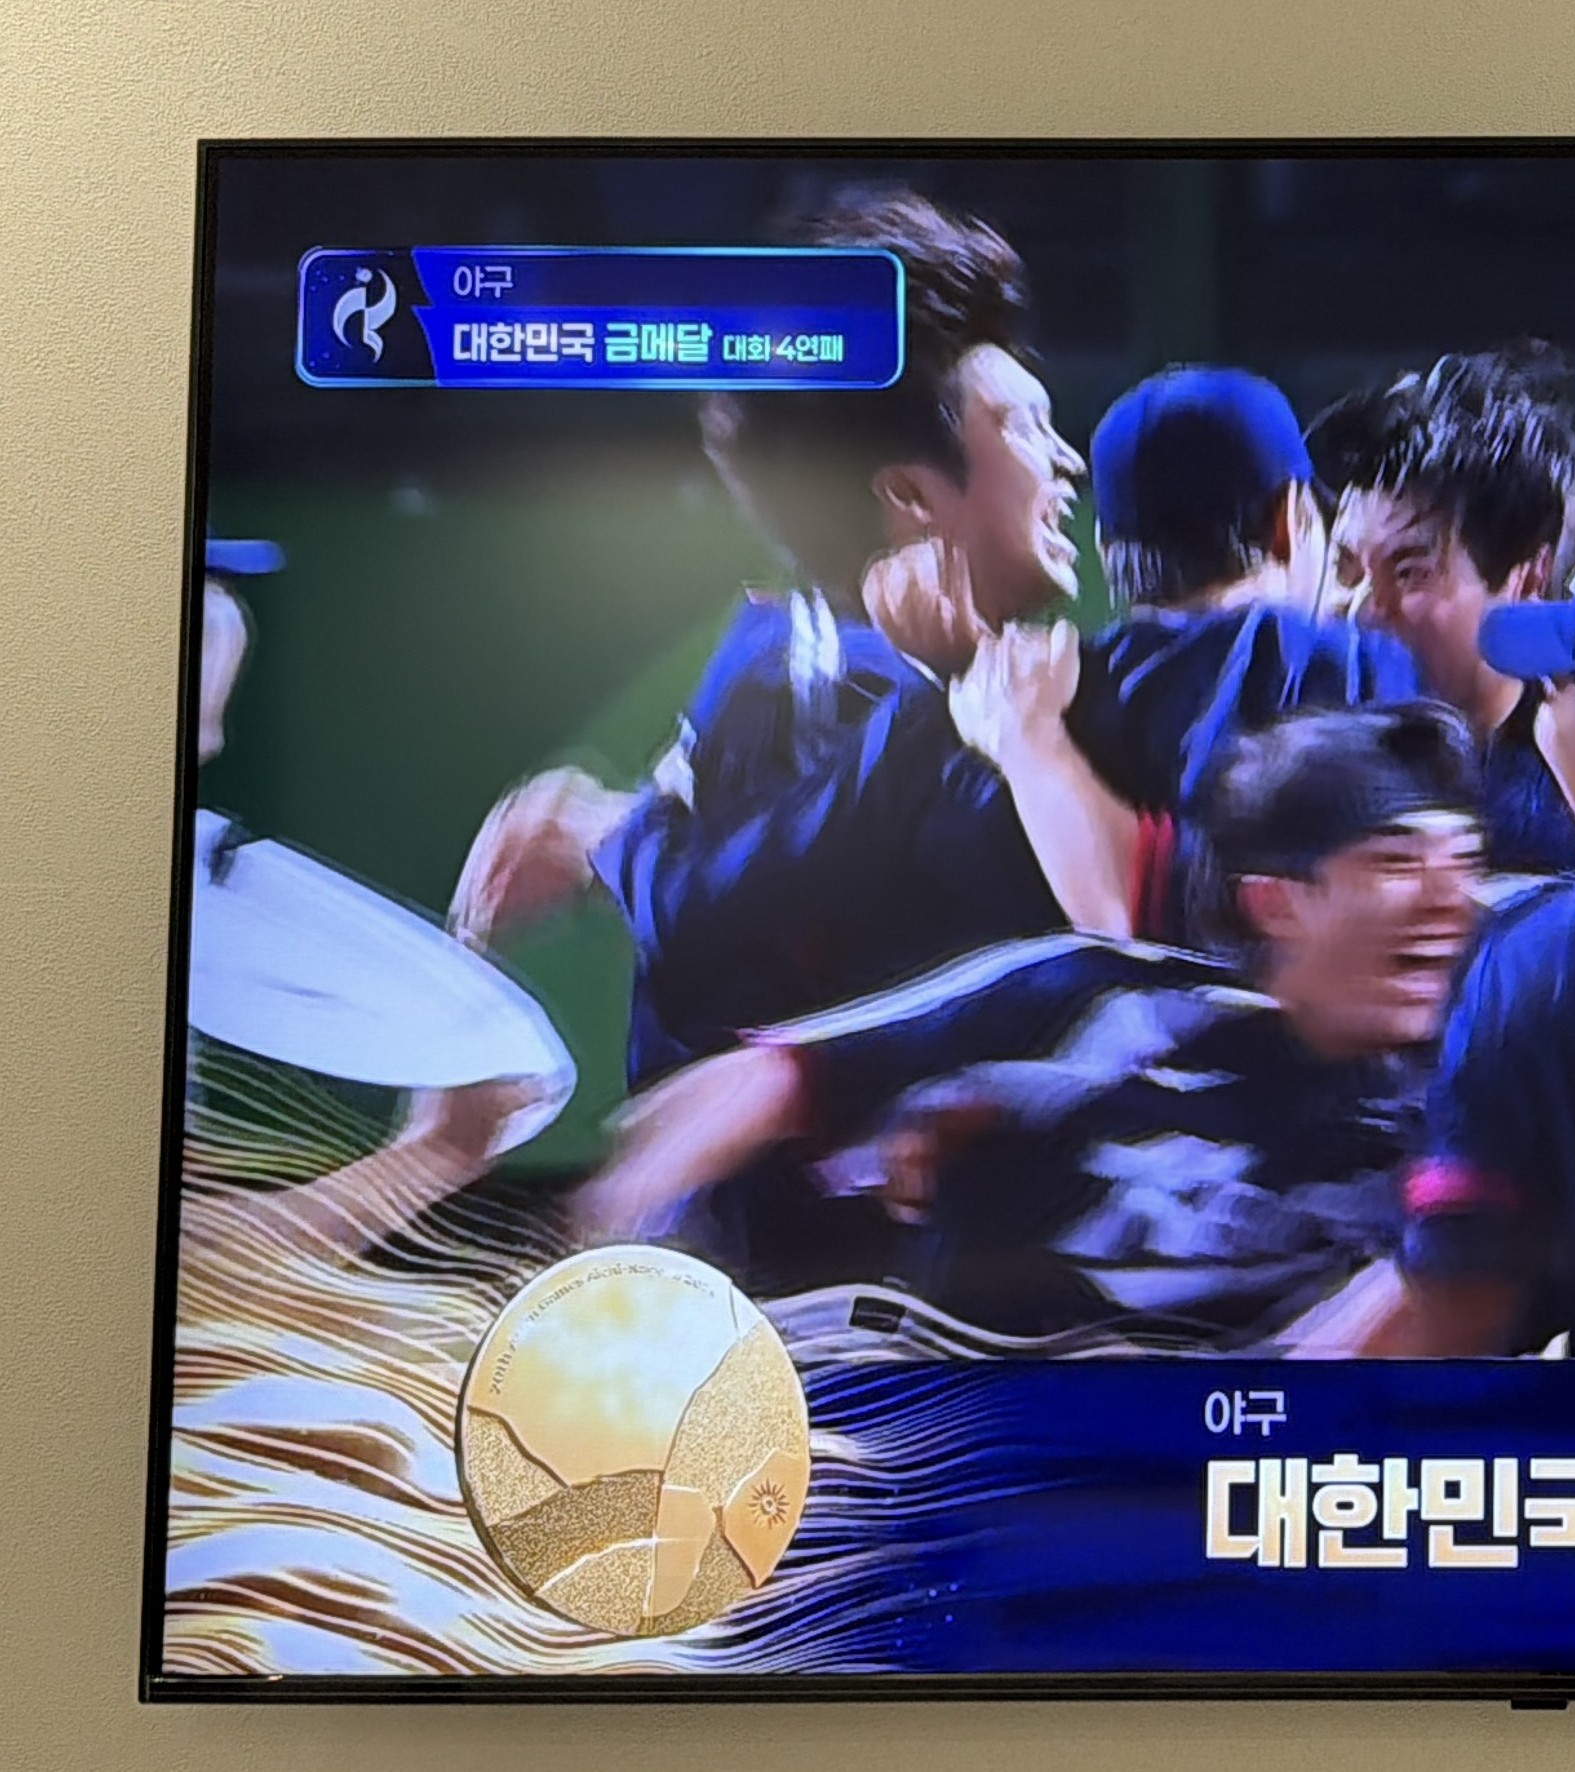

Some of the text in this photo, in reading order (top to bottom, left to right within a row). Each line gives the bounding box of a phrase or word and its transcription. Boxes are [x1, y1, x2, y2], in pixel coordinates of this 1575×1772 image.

[453, 265, 514, 297] 야구
[453, 322, 844, 363] 대한민국 금메달 대회 4연패
[1203, 1389, 1287, 1436] 야구
